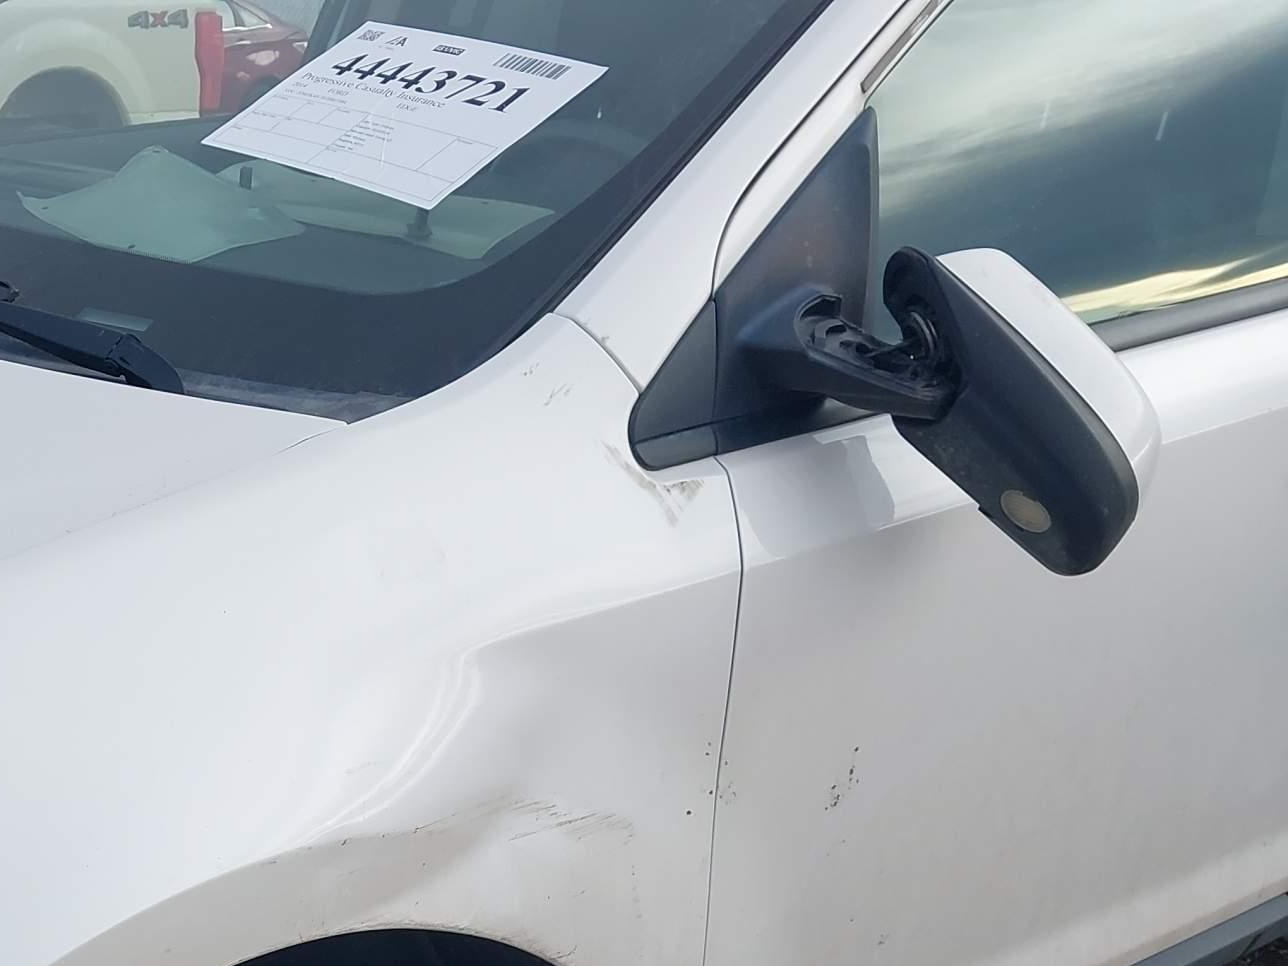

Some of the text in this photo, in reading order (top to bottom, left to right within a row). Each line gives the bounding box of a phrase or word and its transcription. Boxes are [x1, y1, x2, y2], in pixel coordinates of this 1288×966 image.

[302, 72, 355, 89] Progressive
[355, 81, 396, 98] Casualty
[396, 91, 447, 108] Insurance
[331, 53, 532, 113] 44443721
